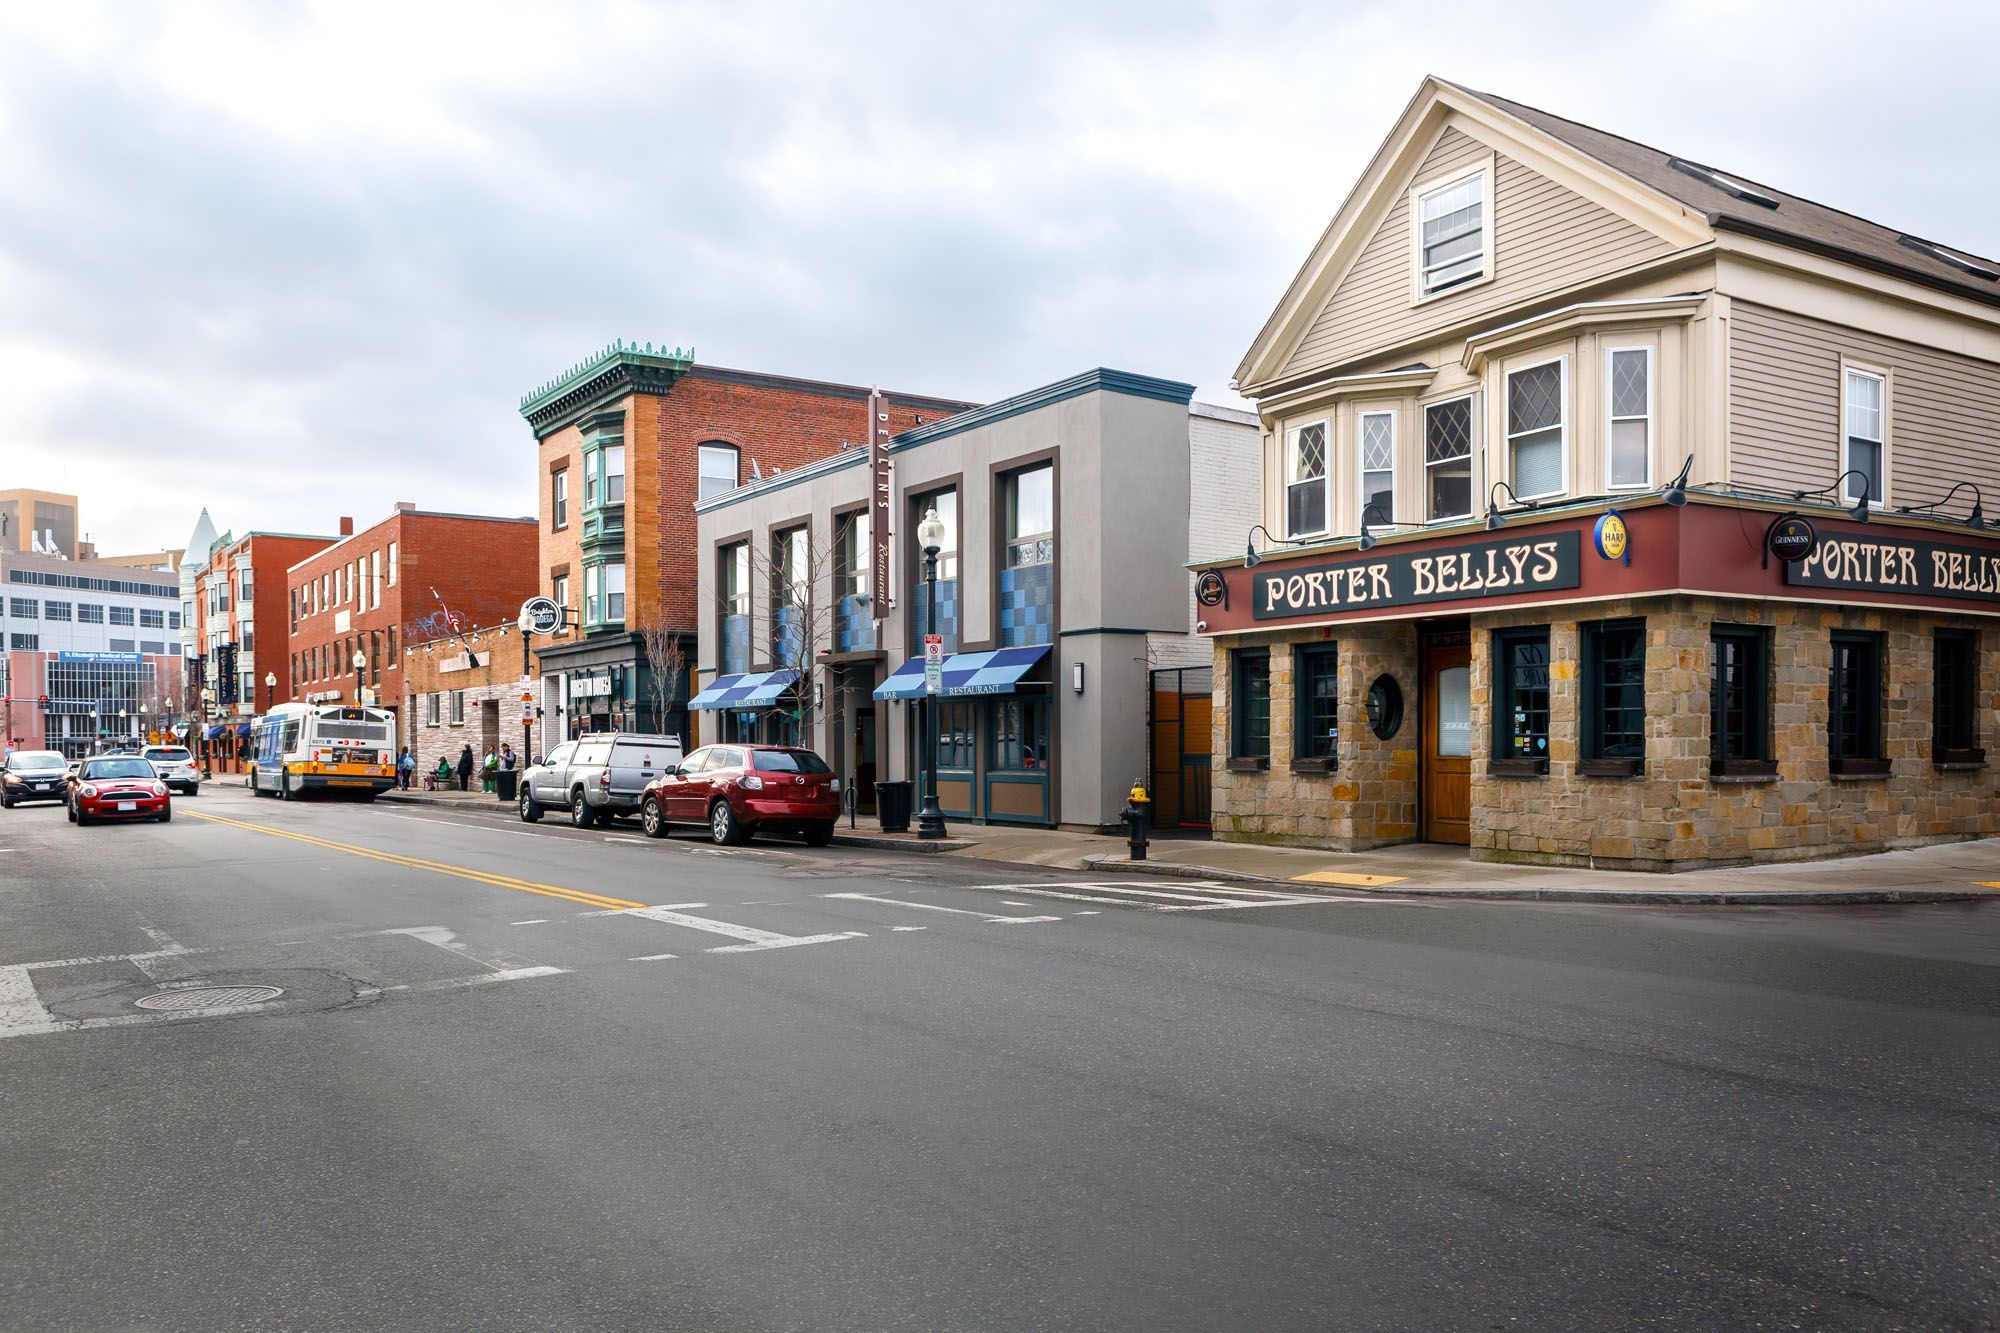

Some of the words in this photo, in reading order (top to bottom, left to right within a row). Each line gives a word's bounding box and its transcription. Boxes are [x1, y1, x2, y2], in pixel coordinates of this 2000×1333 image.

[878, 413, 888, 508] DEVLIN'S
[1605, 532, 1623, 543] HARP
[1775, 535, 1809, 544] GUINNESS
[878, 542, 888, 605] Restaurant
[1265, 563, 1392, 611] PORTER
[1410, 541, 1559, 596] BELLYS
[1802, 540, 1919, 586] PORTER
[883, 691, 897, 700] BAR
[948, 684, 1000, 696] RESTAURANT
